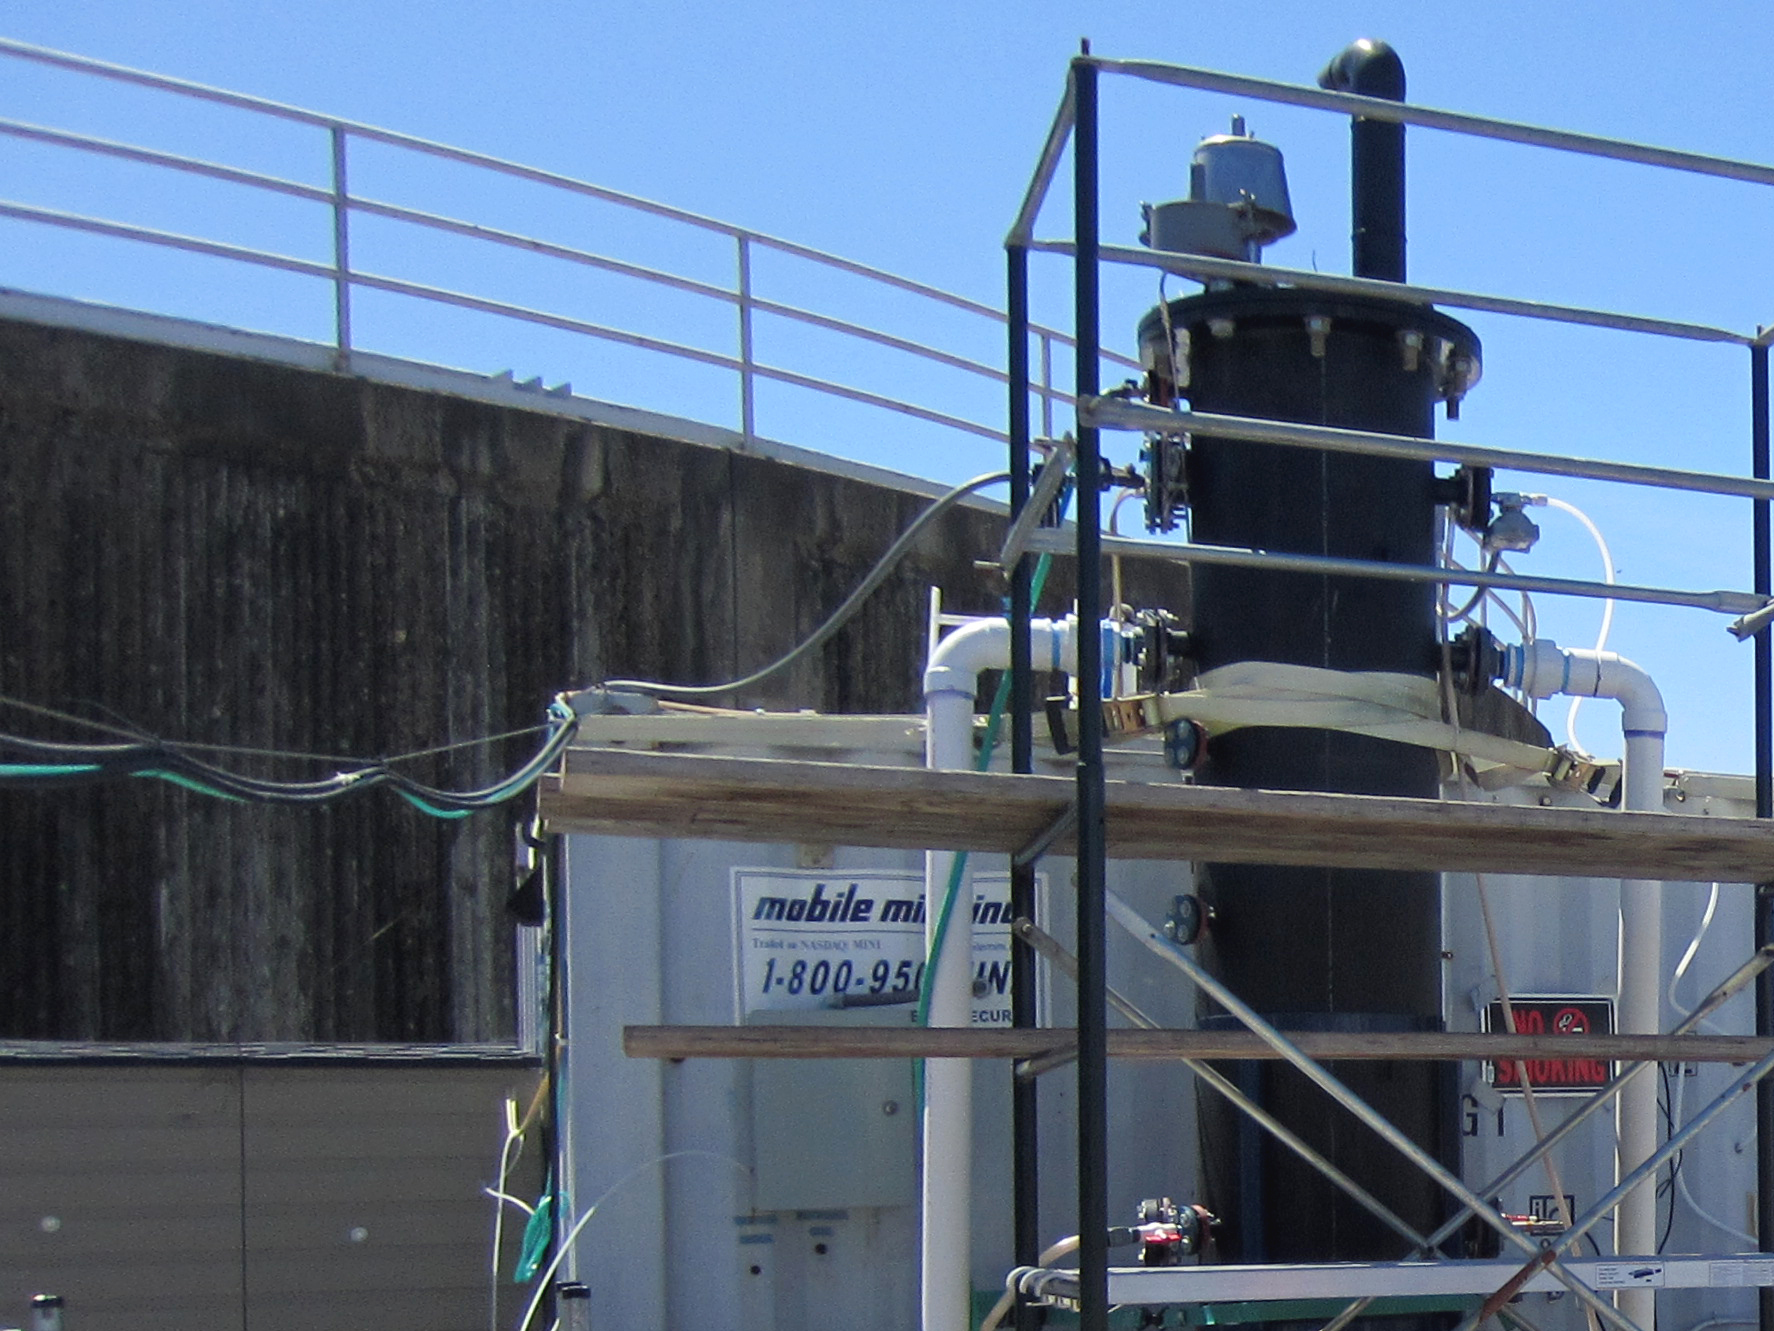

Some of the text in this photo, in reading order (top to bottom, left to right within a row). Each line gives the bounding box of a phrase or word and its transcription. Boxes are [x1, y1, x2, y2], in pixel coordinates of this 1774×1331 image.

[752, 883, 875, 923] mobile
[878, 893, 927, 924] mi
[972, 1009, 1012, 1022] ECUR
